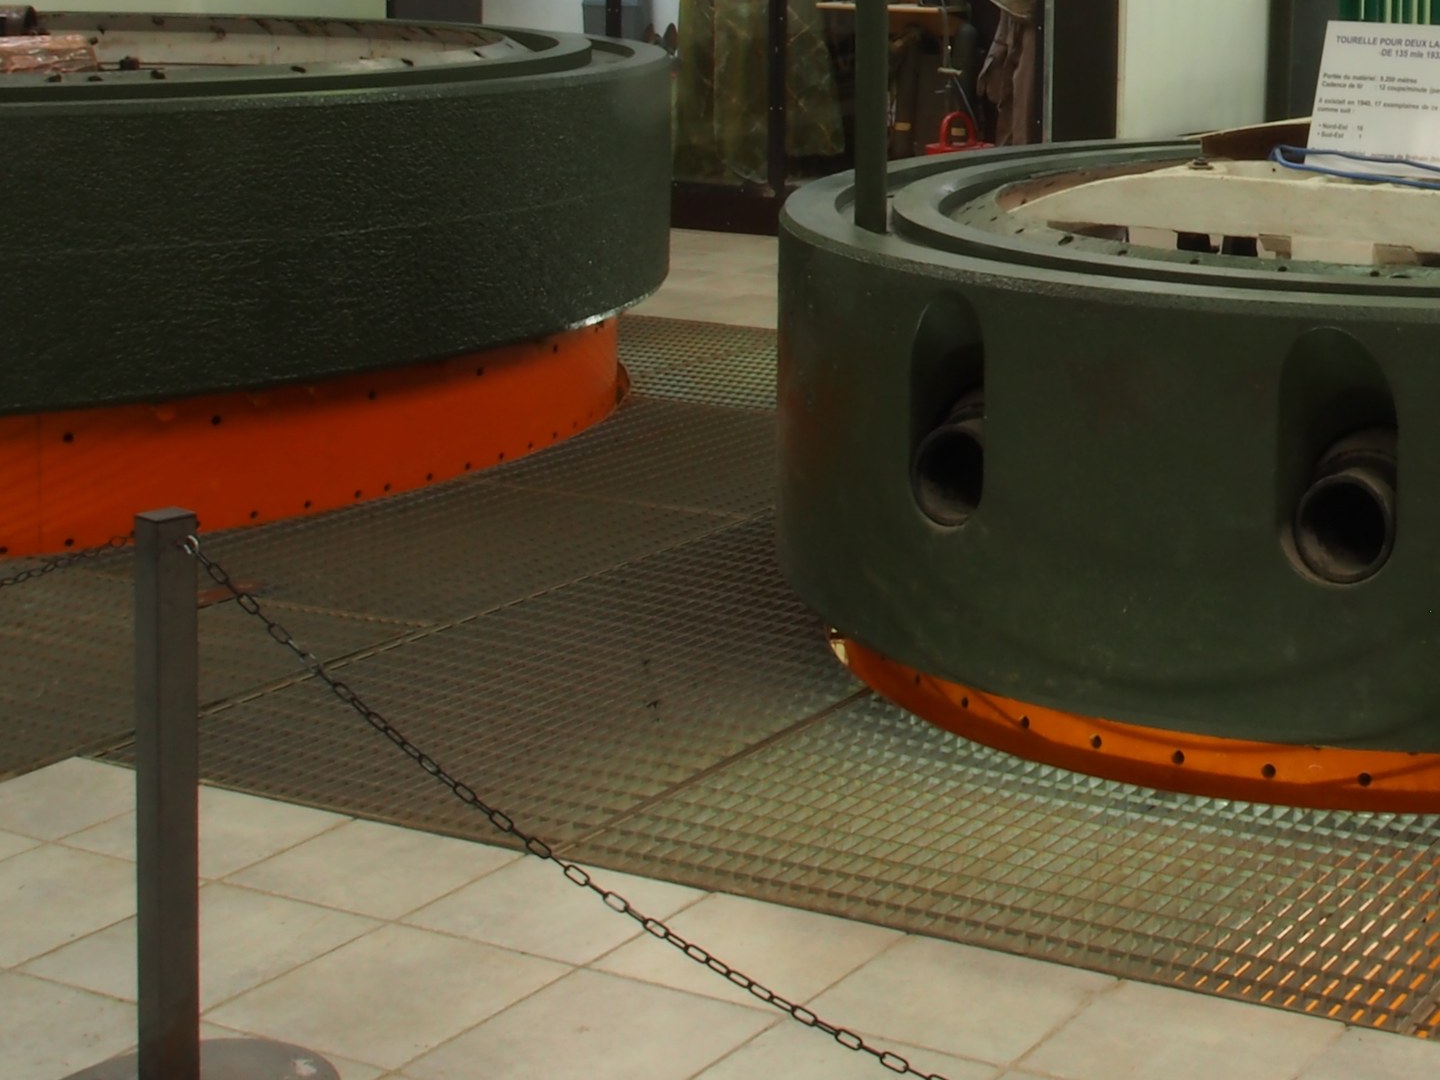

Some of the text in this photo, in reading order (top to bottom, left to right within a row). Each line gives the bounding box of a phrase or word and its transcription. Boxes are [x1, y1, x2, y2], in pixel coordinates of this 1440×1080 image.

[1336, 35, 1378, 46] TOURELLE
[1379, 38, 1404, 47] POUR
[1404, 39, 1427, 48] DEUX
[1380, 48, 1393, 57] DE
[1395, 49, 1408, 58] 135
